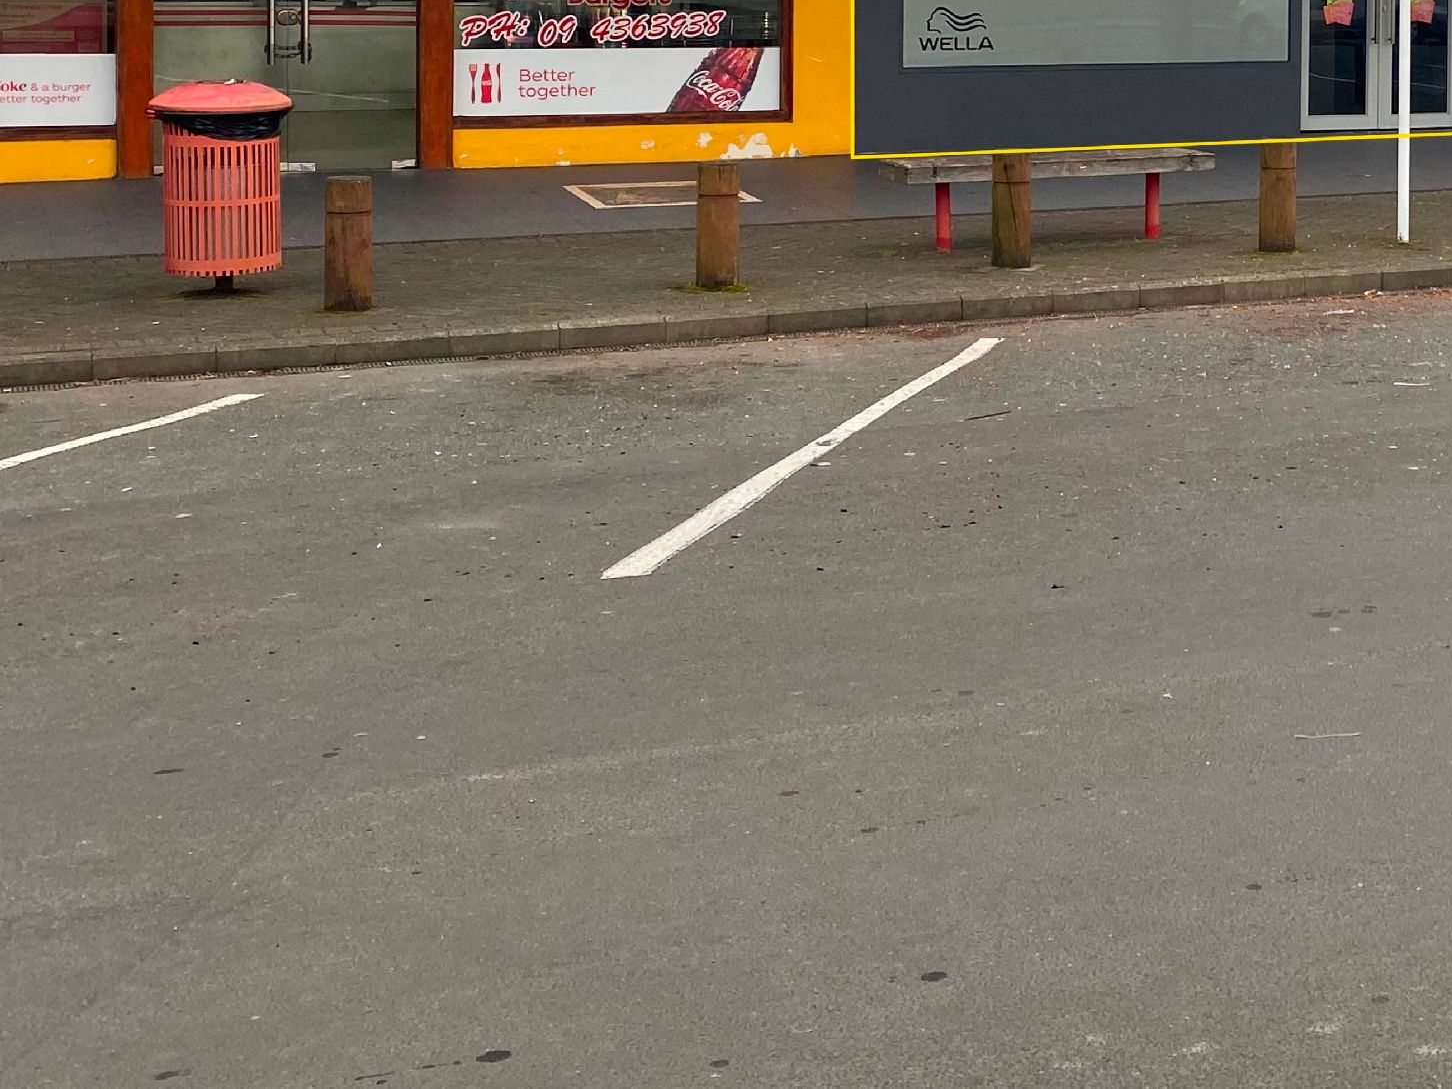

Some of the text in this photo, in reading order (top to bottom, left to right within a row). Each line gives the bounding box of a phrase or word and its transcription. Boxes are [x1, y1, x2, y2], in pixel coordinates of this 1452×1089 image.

[459, 10, 727, 48] PH: 09 4363938
[918, 35, 994, 52] WELLA
[519, 67, 576, 83] Better
[0, 80, 27, 92] oke
[52, 83, 92, 93] burger
[518, 83, 597, 100] together
[0, 95, 82, 105] etter together
